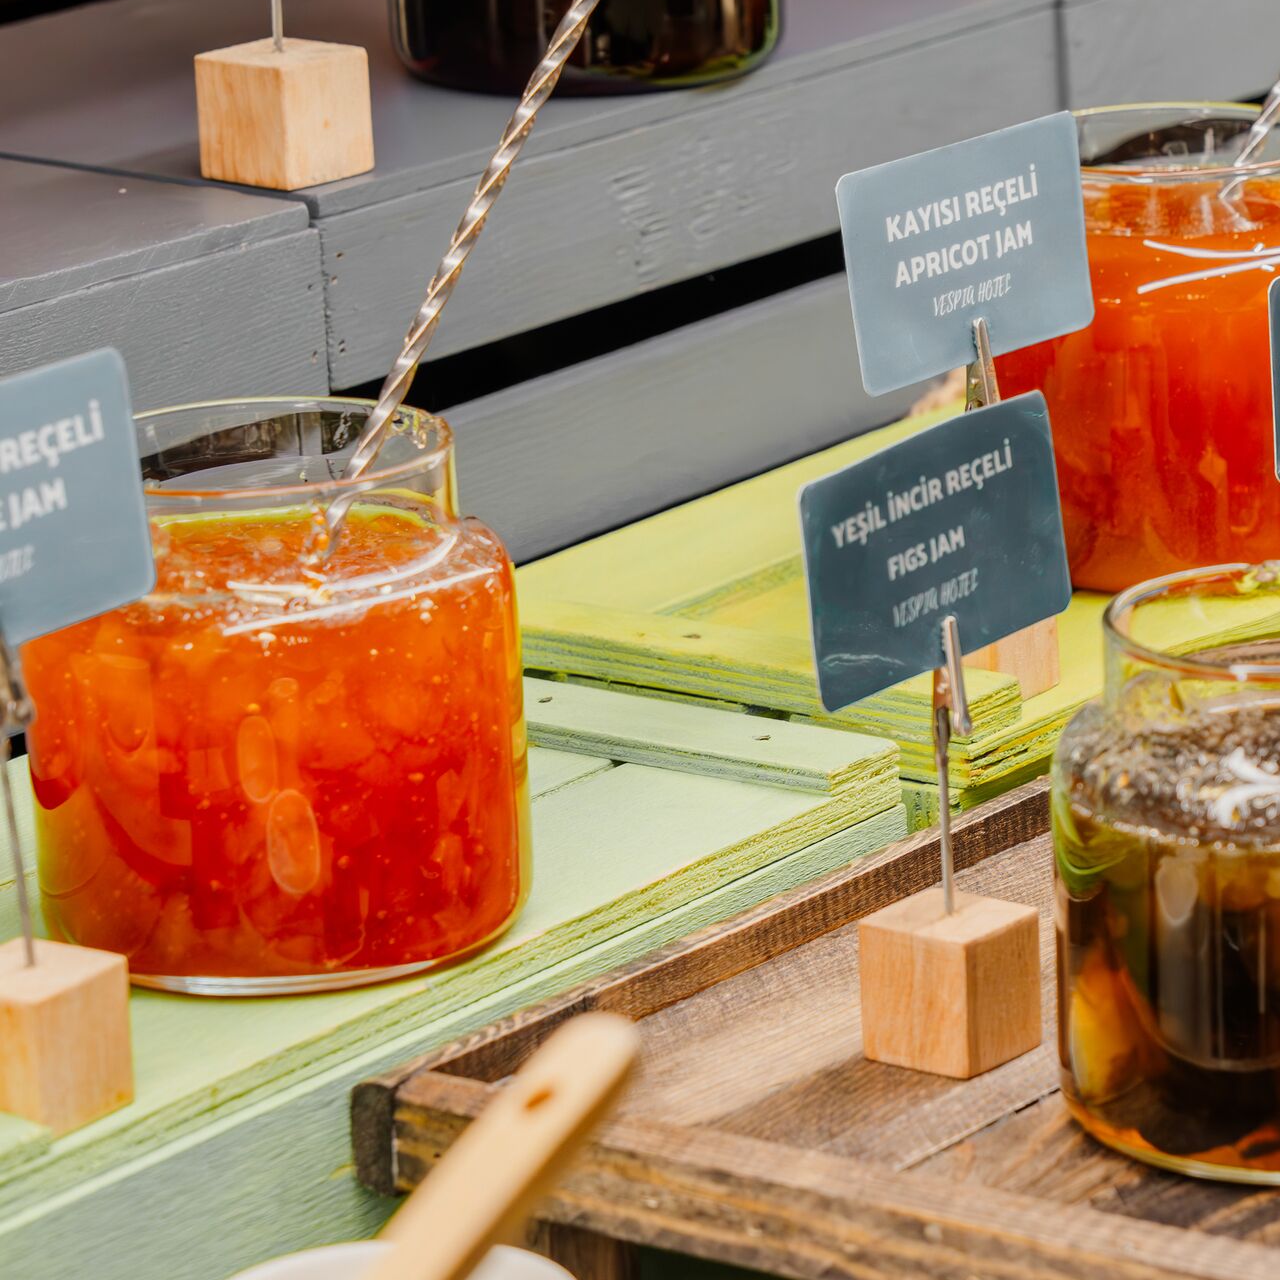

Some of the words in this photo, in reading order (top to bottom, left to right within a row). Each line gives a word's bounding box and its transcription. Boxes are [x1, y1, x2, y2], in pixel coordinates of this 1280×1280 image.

[886, 196, 961, 243] KAYISI
[965, 164, 1039, 216] REÇELİ
[895, 234, 991, 288] APRICOT
[995, 220, 1033, 258] JAM
[978, 273, 1012, 303] HOTEL
[0, 398, 104, 474] REÇELİ
[8, 477, 67, 529] JAM
[831, 501, 887, 548] YEŞİL
[887, 475, 944, 523] İNCİR
[945, 438, 1012, 496] REÇELİ
[887, 545, 928, 581] FIGS
[930, 525, 965, 564] JAM
